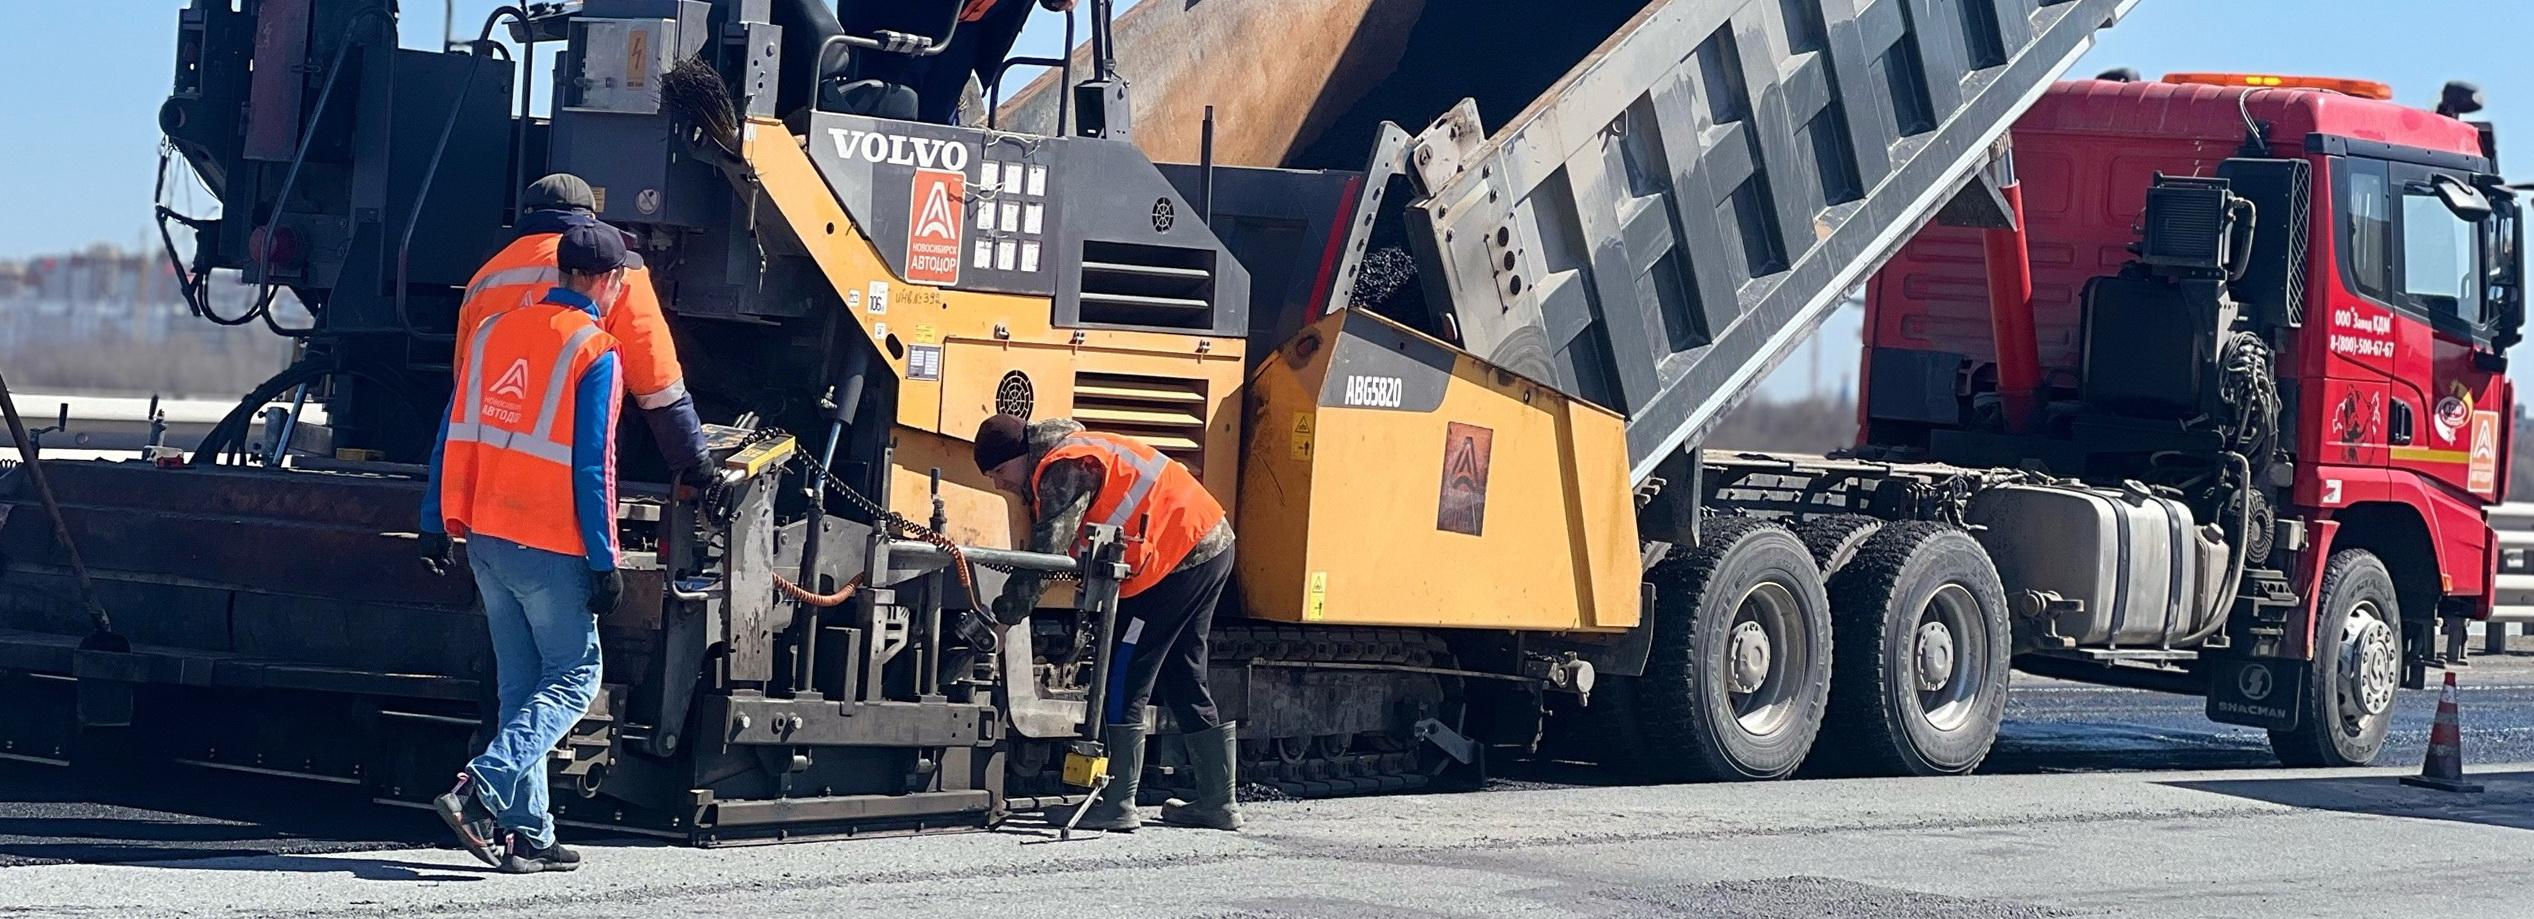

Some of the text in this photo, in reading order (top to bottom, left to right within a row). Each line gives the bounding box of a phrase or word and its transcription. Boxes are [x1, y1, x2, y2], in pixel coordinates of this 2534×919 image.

[828, 127, 968, 171] VOLVO
[911, 254, 956, 274] АВТОДОР
[2335, 309, 2351, 328] ООО
[2330, 334, 2395, 358] 8-(800)-500-67-67
[1344, 374, 1402, 408] ABG5820
[2218, 701, 2287, 718] SHACMAN
